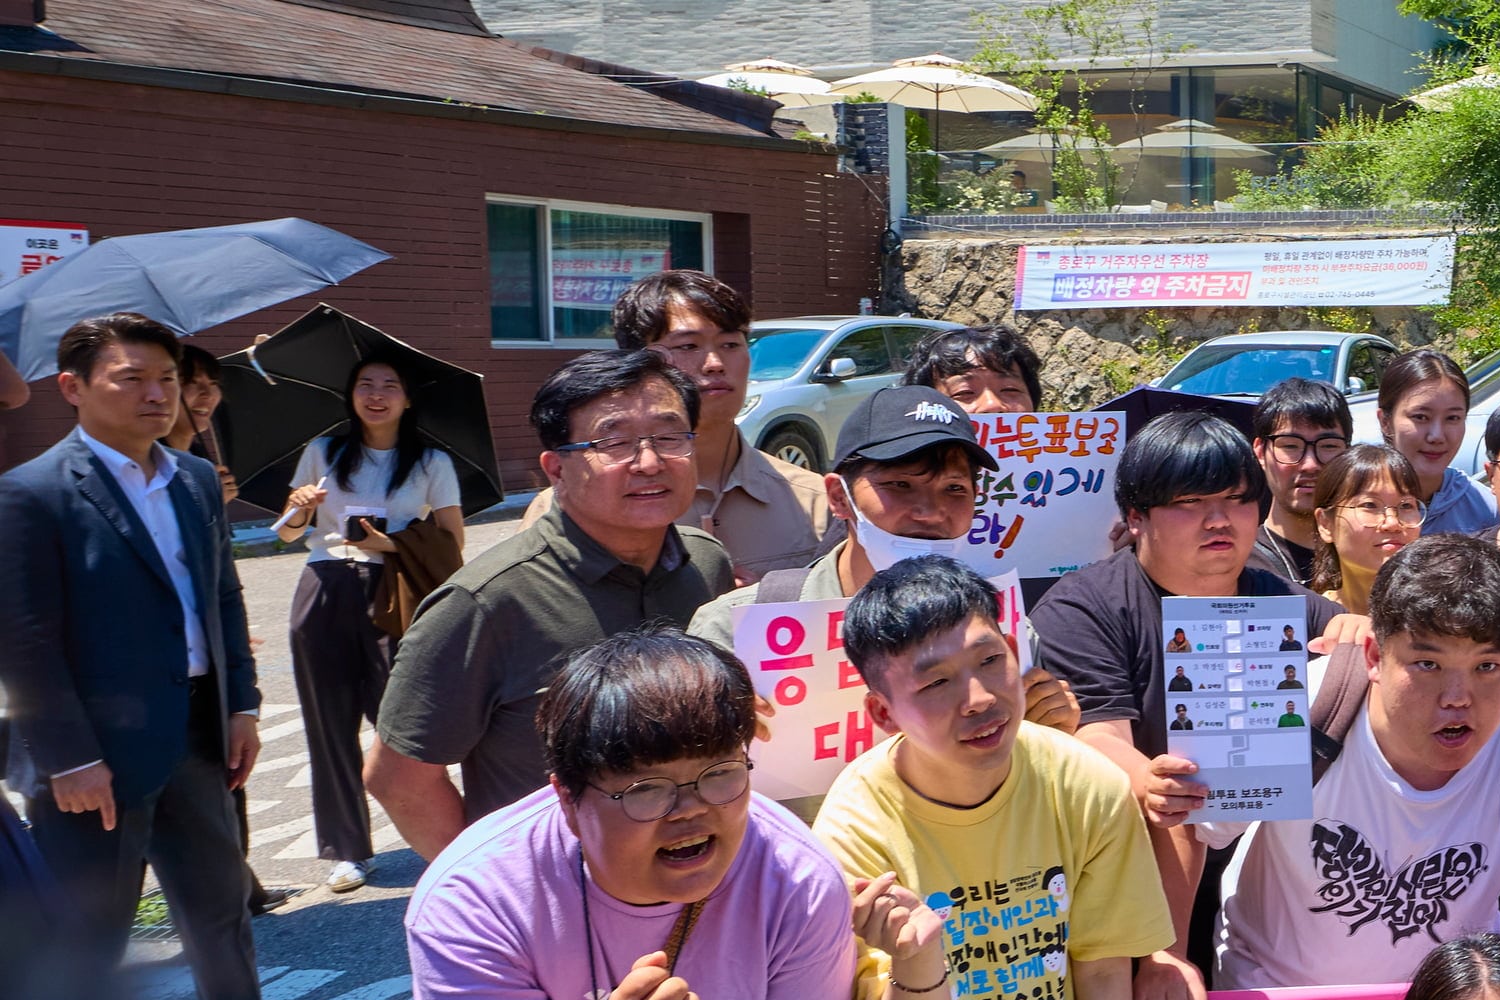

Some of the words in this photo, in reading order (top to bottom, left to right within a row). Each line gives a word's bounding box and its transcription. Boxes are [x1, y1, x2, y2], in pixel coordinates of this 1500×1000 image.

[26, 238, 59, 250] 이곳은
[1301, 251, 1333, 261] 관계없이
[1335, 250, 1375, 260] 배정차량만
[1377, 249, 1393, 258] 주차
[20, 254, 65, 276] 금
[1058, 255, 1096, 270] 종로구
[1101, 254, 1165, 270] 거주자우선
[1169, 253, 1210, 269] 주차장
[1055, 275, 1136, 300] 배정차량
[1139, 275, 1160, 297] 외
[1165, 274, 1249, 298] 주차금지
[1241, 787, 1284, 799] 보조용구
[949, 879, 1010, 911] 우리는
[942, 894, 1060, 947] 달장애인과
[956, 969, 994, 997] 서로
[994, 955, 1046, 994] 함께
